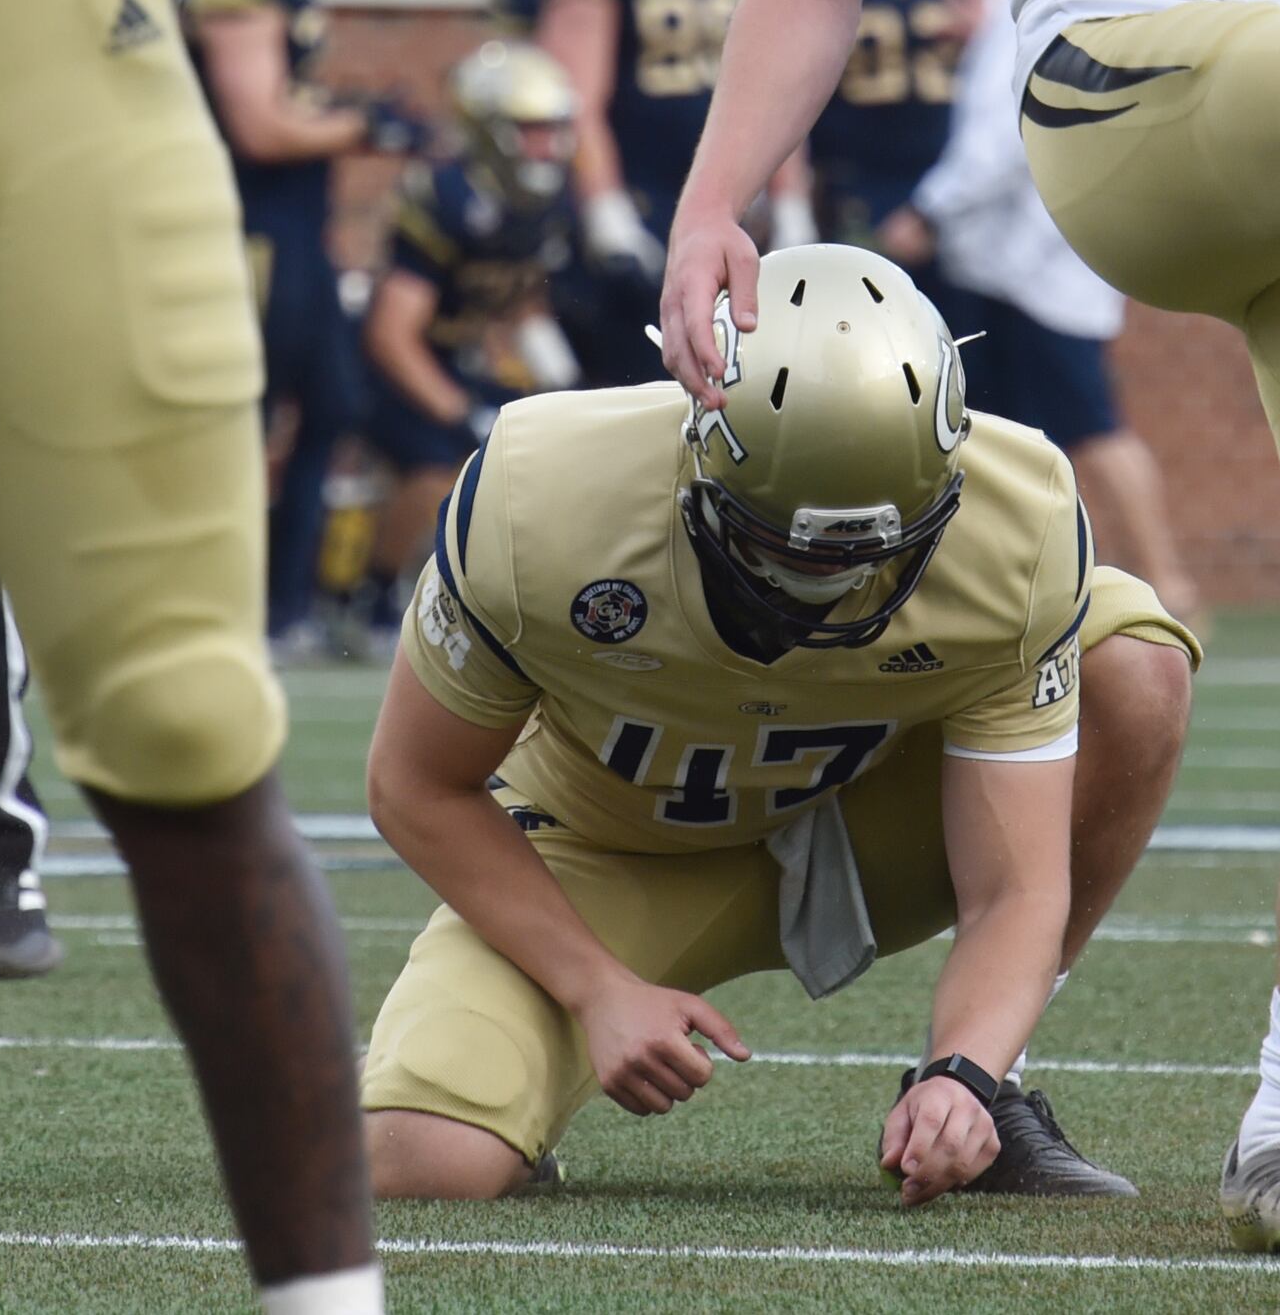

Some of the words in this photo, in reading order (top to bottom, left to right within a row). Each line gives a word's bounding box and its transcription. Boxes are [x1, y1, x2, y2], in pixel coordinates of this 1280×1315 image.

[824, 517, 877, 534] ACC
[879, 660, 944, 673] adidas
[598, 714, 898, 828] 47
